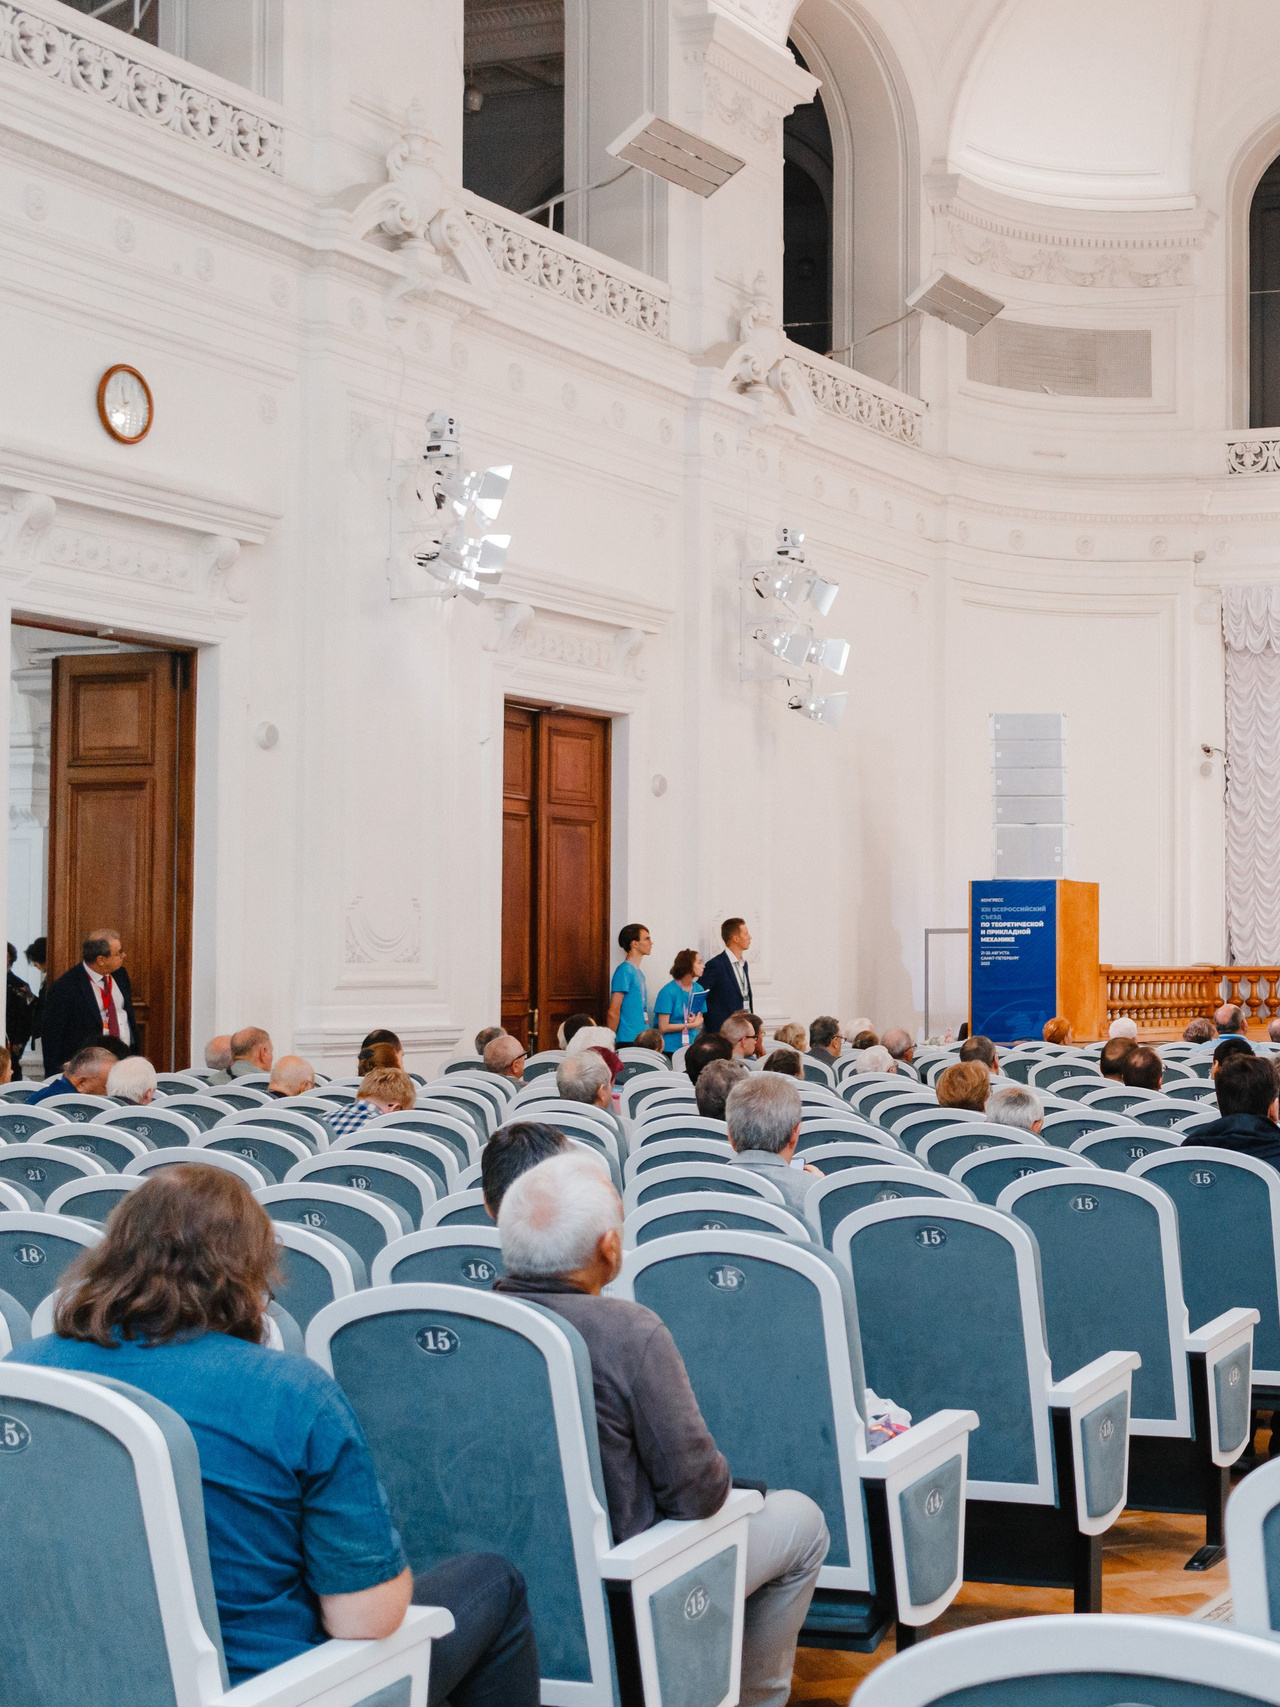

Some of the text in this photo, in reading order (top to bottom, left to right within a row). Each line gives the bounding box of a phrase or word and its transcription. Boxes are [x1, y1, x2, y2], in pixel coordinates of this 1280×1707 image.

[74, 1112, 84, 1121] 25
[14, 1125, 26, 1133] 24
[137, 1126, 148, 1136] 23
[241, 1149, 254, 1159] 21
[1130, 1148, 1144, 1158] 16
[28, 1170, 42, 1181] 21
[1194, 1173, 1211, 1185] 15
[351, 1178, 366, 1190] 19
[1076, 1198, 1094, 1211] 15
[304, 1213, 321, 1226] 18
[921, 1230, 941, 1246] 15
[20, 1247, 38, 1263] 18
[468, 1264, 490, 1279] 16
[716, 1270, 738, 1286] 15
[424, 1331, 451, 1350] 15
[928, 1491, 942, 1512] 14
[688, 1587, 706, 1616] 15
